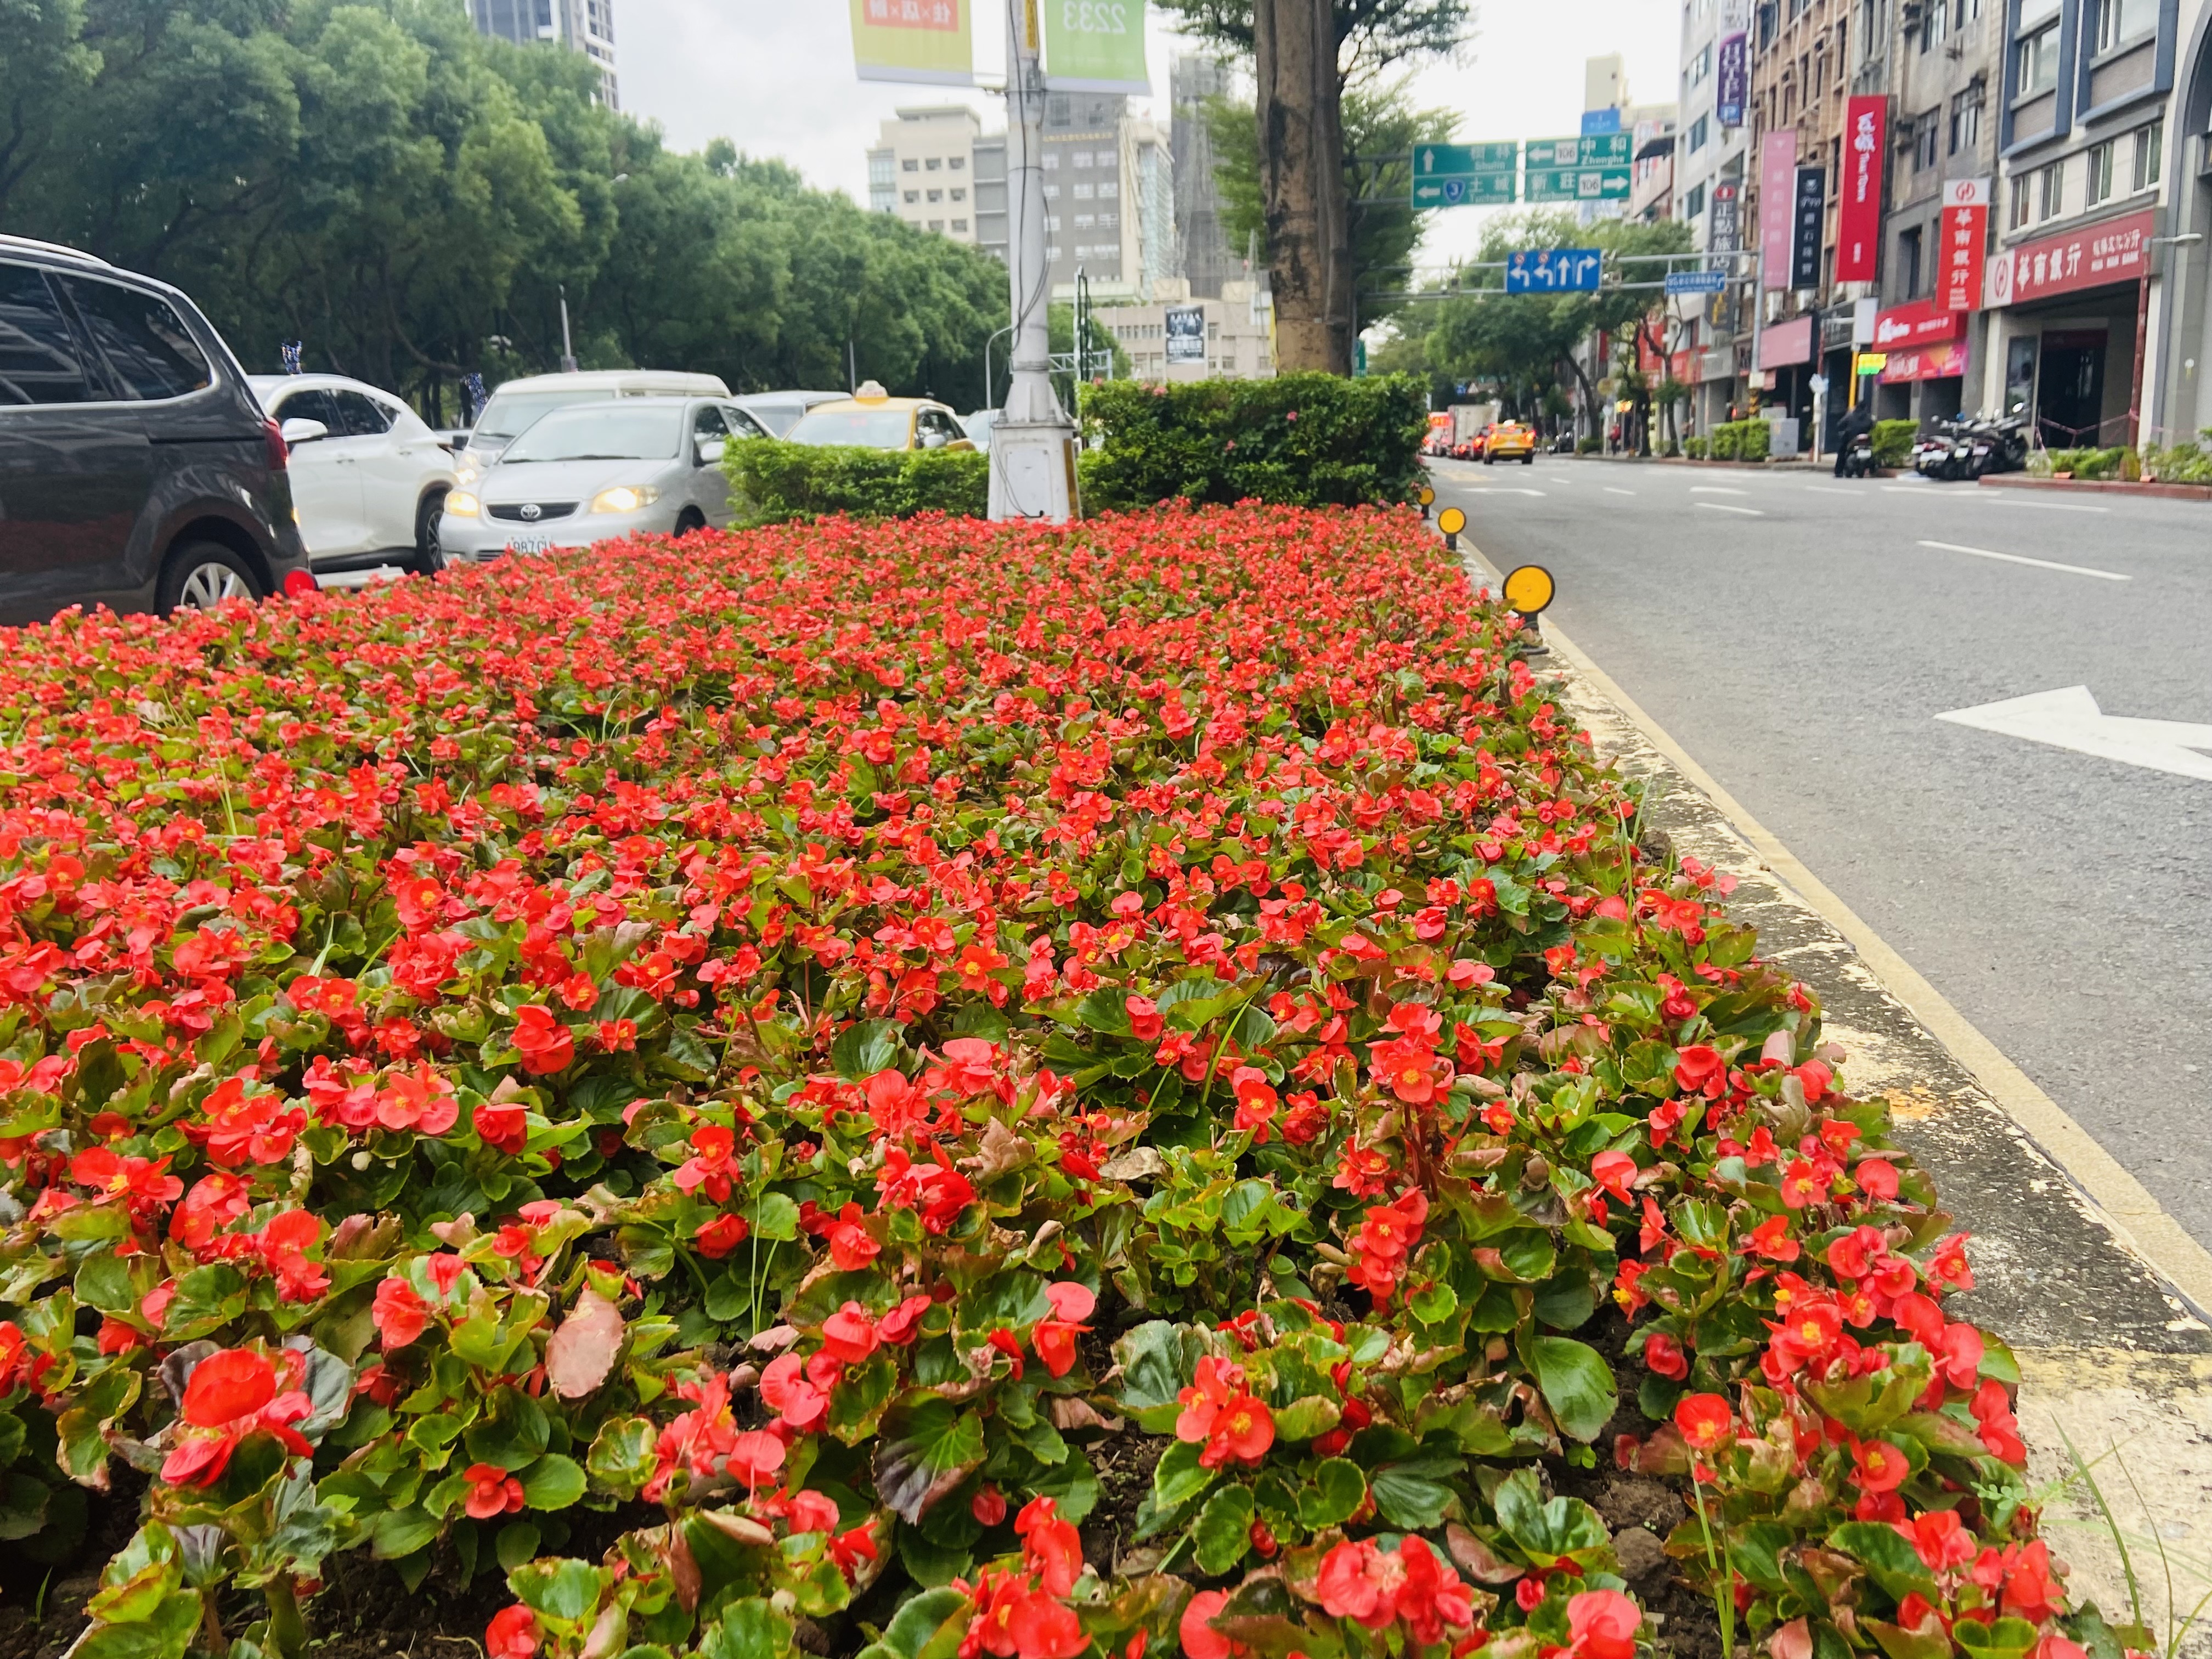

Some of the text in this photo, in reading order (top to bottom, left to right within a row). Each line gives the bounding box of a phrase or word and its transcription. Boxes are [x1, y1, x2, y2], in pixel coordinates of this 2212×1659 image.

[1722, 43, 1741, 103] HOTEL
[1559, 148, 1575, 159] 106
[1581, 136, 1627, 157] 中和
[1581, 154, 1624, 167] Zhonghe
[1451, 183, 1459, 196] 3
[1468, 176, 1509, 193] 土城
[1582, 179, 1599, 191] 106
[1951, 208, 1973, 286] 華南銀行
[2017, 242, 2081, 294] 華南銀行
